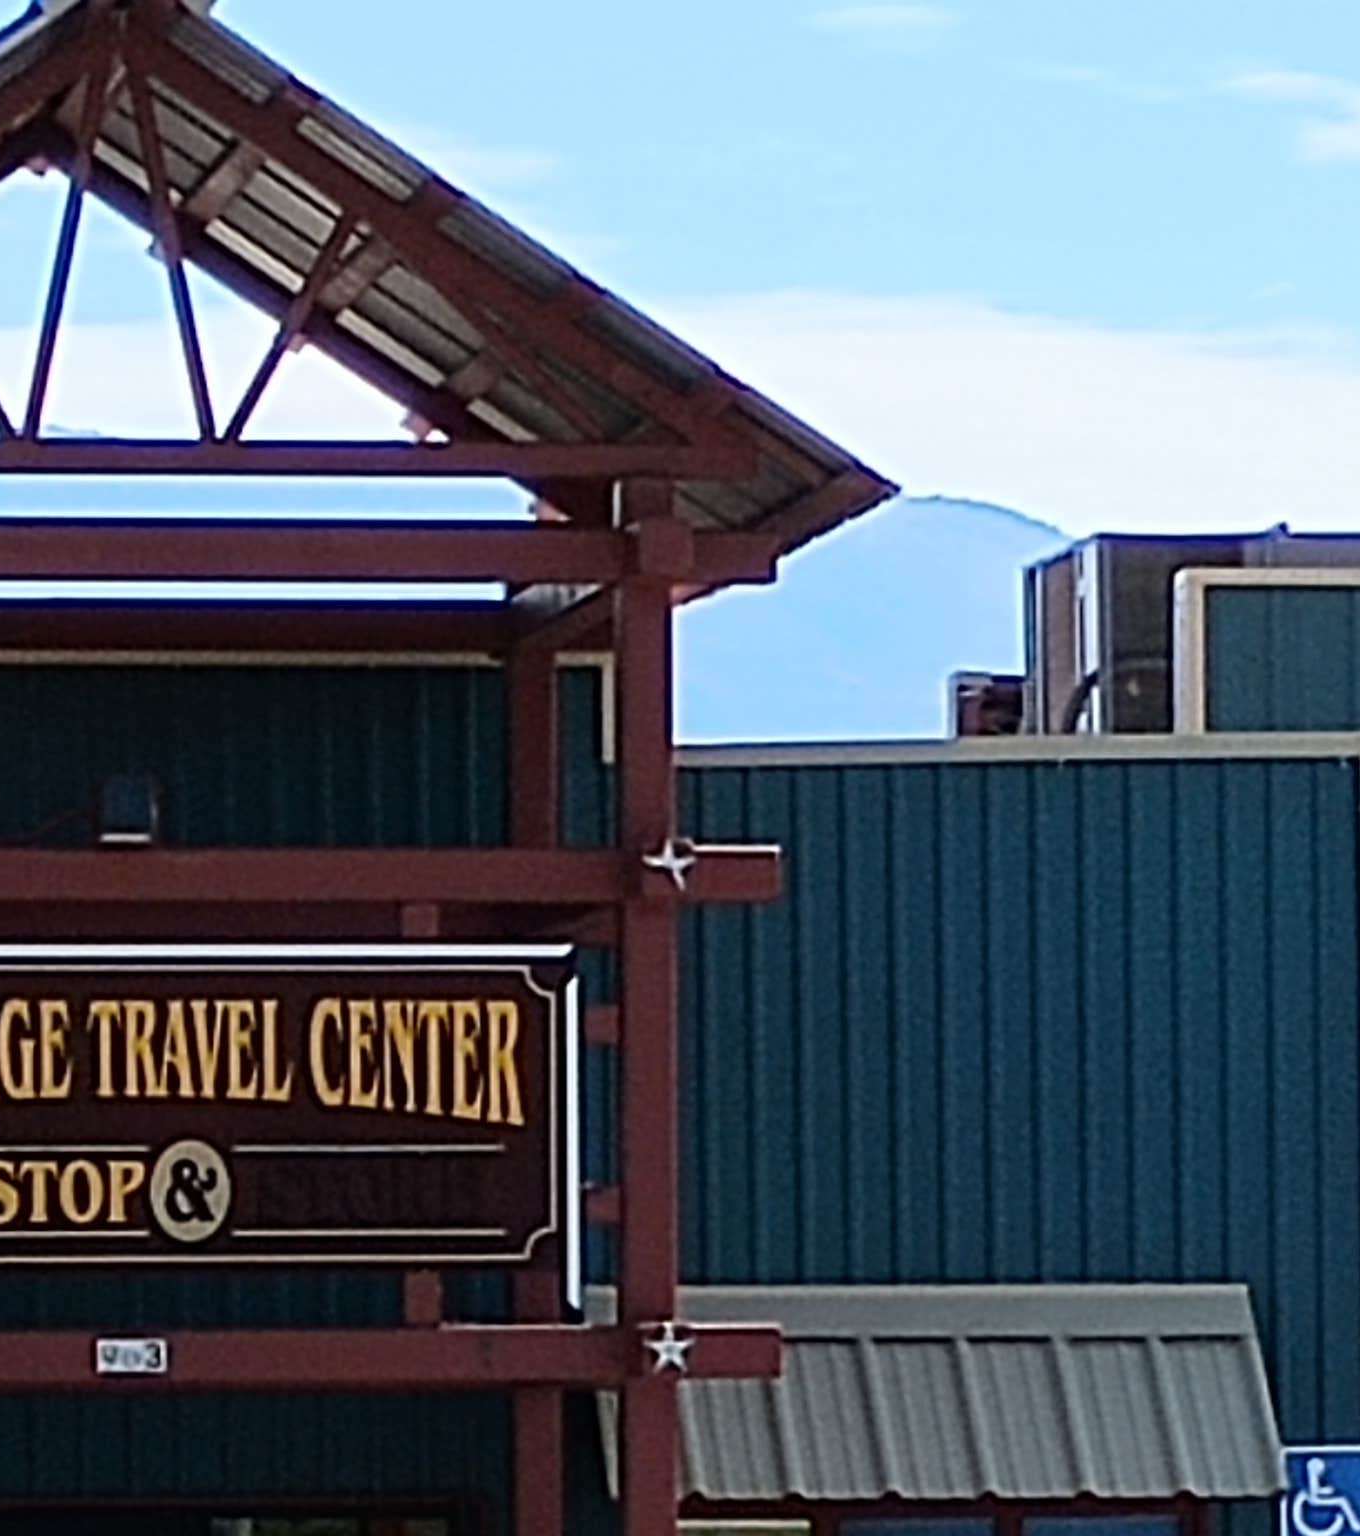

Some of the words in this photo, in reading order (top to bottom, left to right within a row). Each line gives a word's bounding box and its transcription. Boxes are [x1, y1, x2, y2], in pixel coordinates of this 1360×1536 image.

[87, 998, 293, 1101] TRAVEL
[309, 998, 525, 1126] CENTER
[164, 1158, 218, 1223] &
